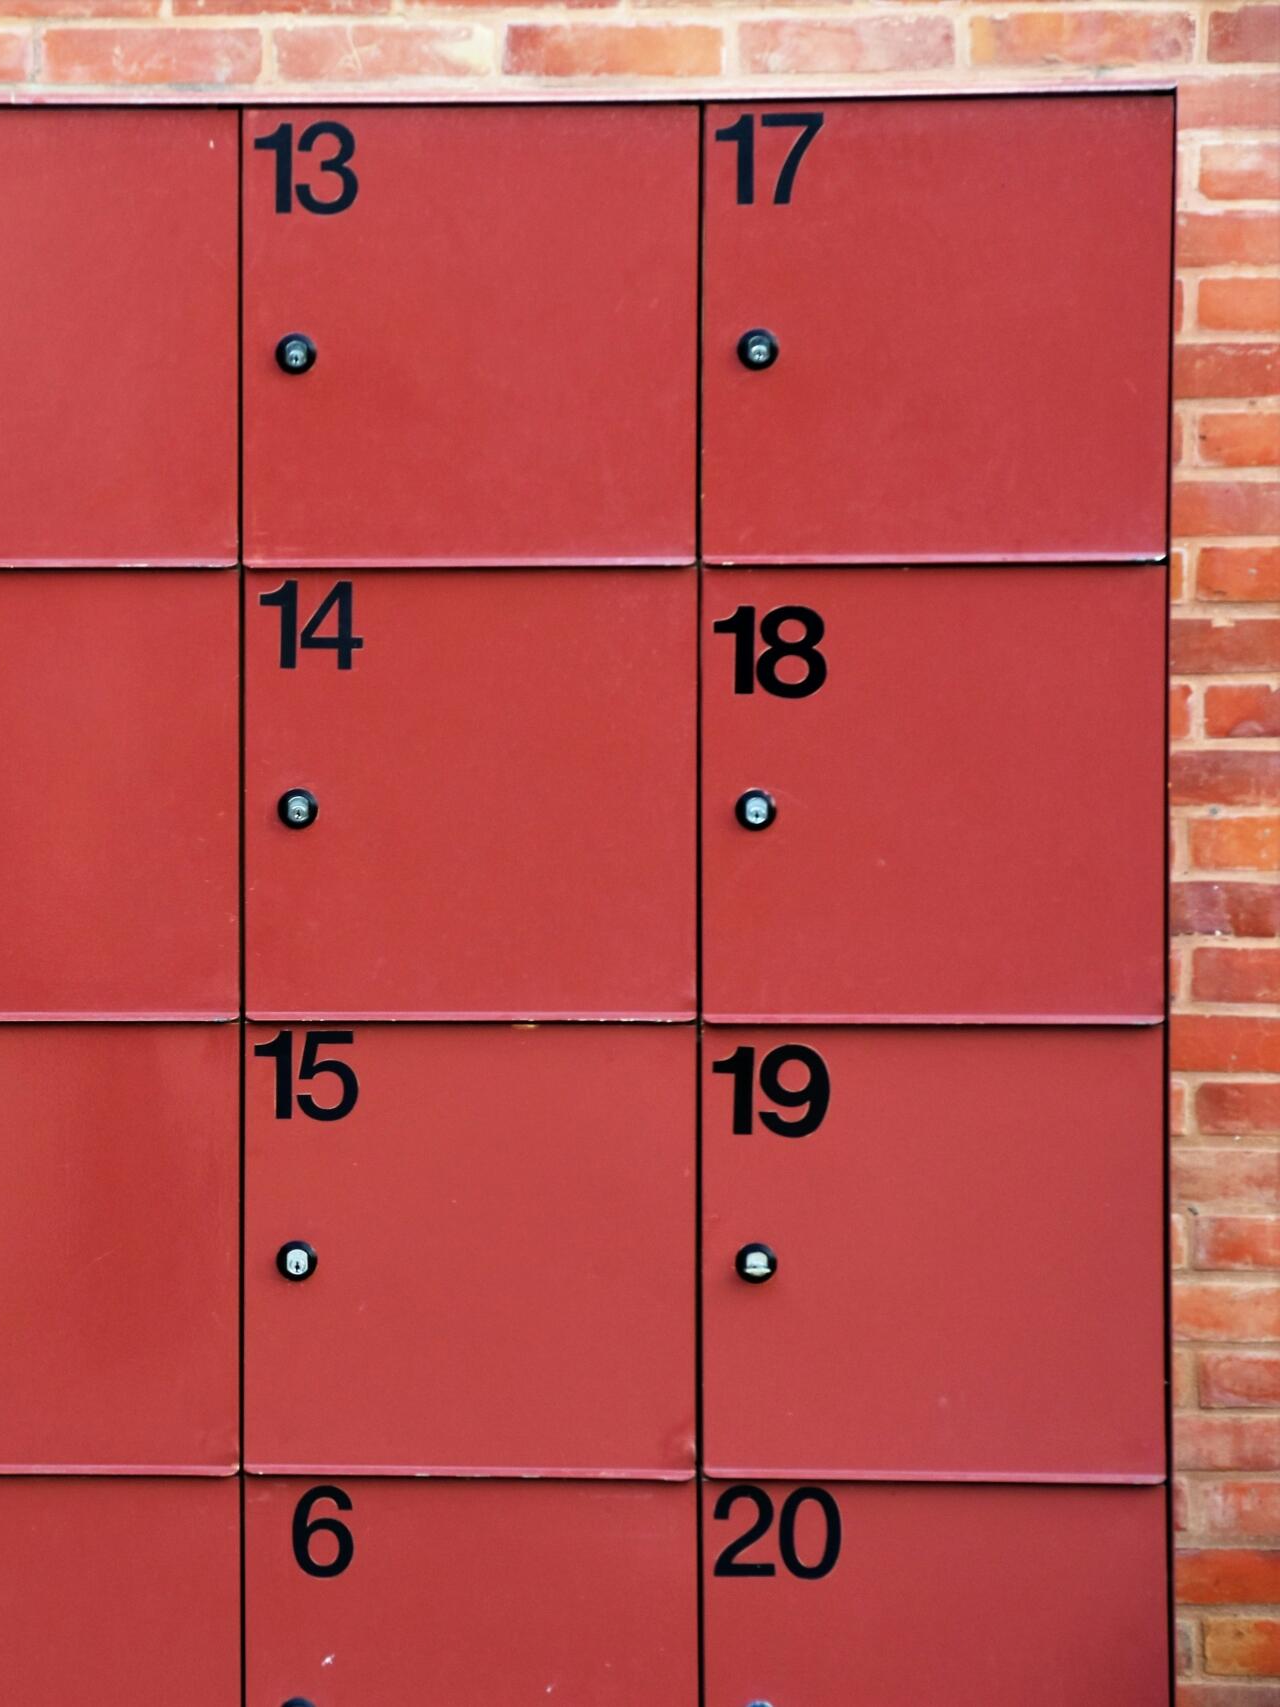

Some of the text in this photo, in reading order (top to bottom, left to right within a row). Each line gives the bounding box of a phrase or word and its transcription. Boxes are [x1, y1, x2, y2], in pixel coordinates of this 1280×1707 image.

[254, 121, 358, 214] 13
[715, 112, 823, 204] 17
[260, 580, 363, 669] 14
[714, 606, 827, 699] 18
[254, 1030, 358, 1121] 15
[713, 1045, 830, 1138] 19
[292, 1484, 354, 1578] 6
[713, 1484, 842, 1580] 20
